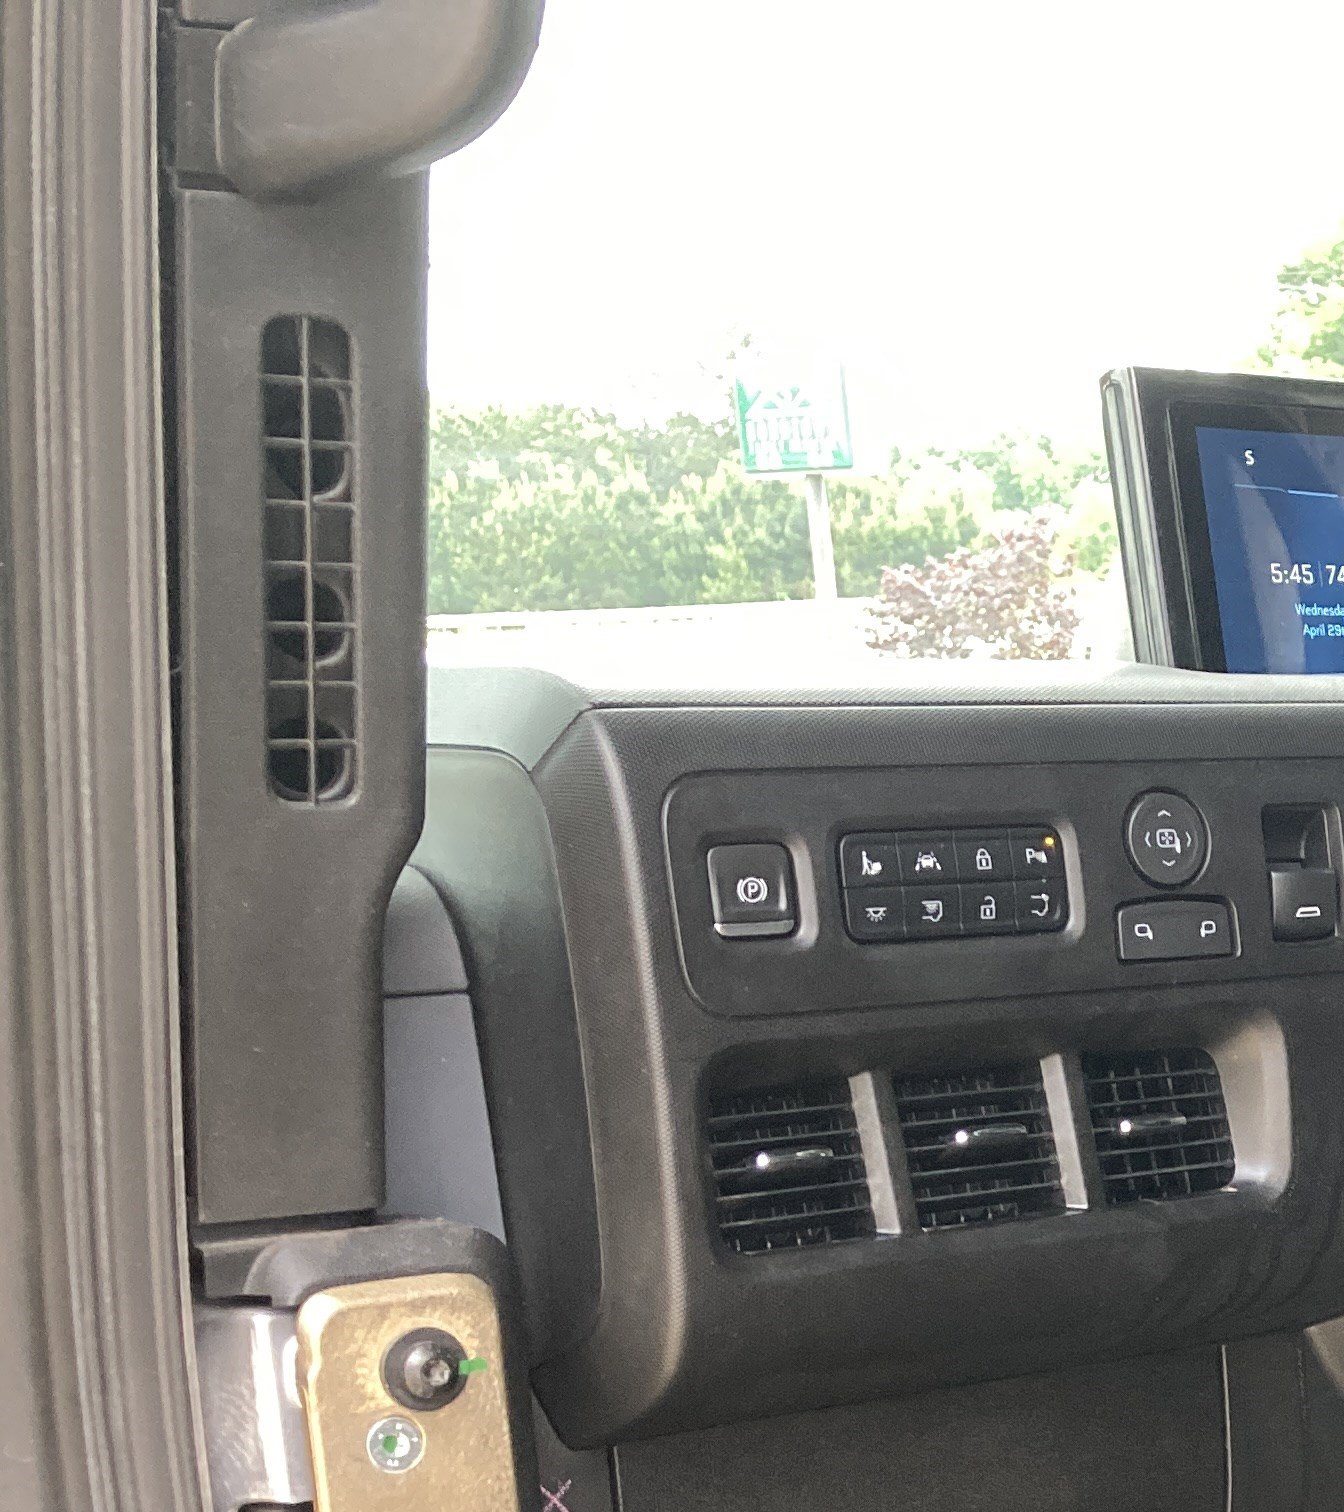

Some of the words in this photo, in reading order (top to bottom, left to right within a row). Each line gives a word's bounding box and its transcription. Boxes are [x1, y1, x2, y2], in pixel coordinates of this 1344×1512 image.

[1244, 449, 1255, 466] S
[1270, 562, 1314, 585] 5:45
[1302, 623, 1326, 640] April
